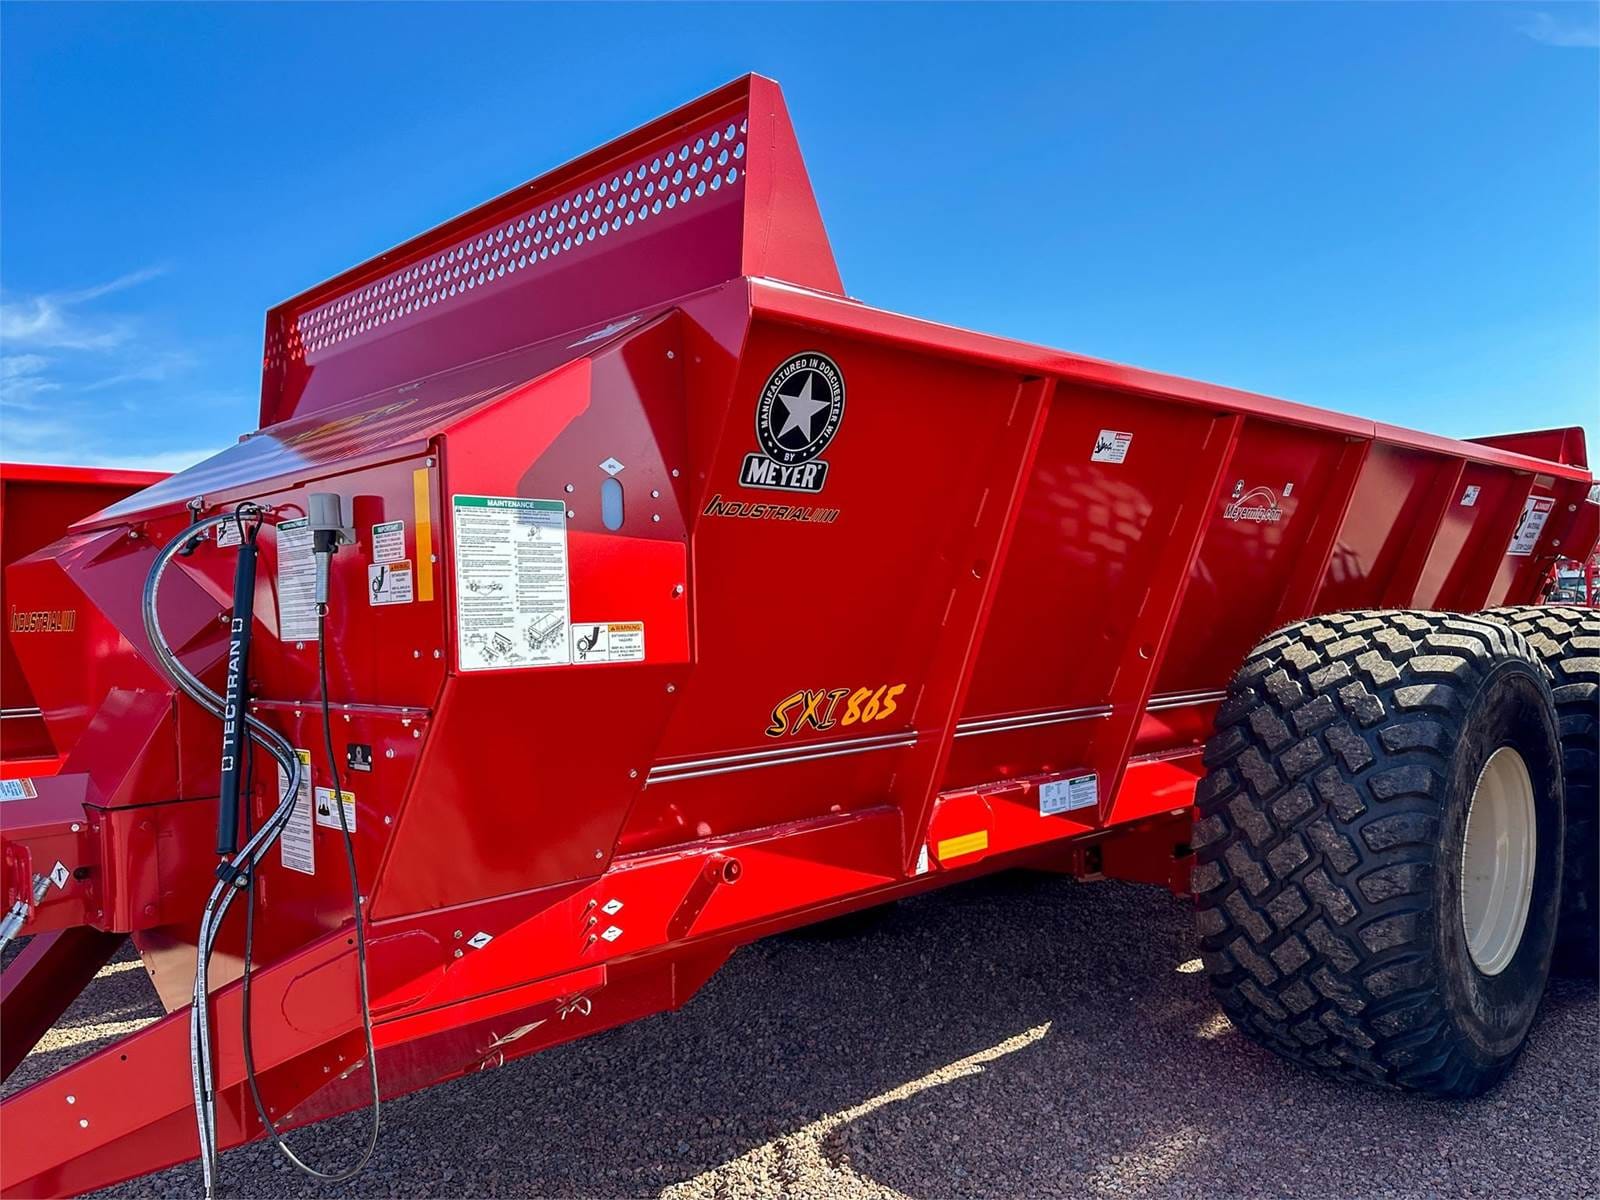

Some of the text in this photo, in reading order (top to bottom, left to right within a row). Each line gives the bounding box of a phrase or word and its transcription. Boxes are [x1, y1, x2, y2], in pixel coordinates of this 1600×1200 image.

[760, 358, 842, 439] MANUFACTURED IN DORCHESTER WI
[747, 458, 818, 489] MEYER
[783, 452, 796, 462] BY
[487, 499, 535, 509] MAINTENANCE
[223, 640, 241, 750] TECTRAN
[765, 683, 907, 738] SXI 865
